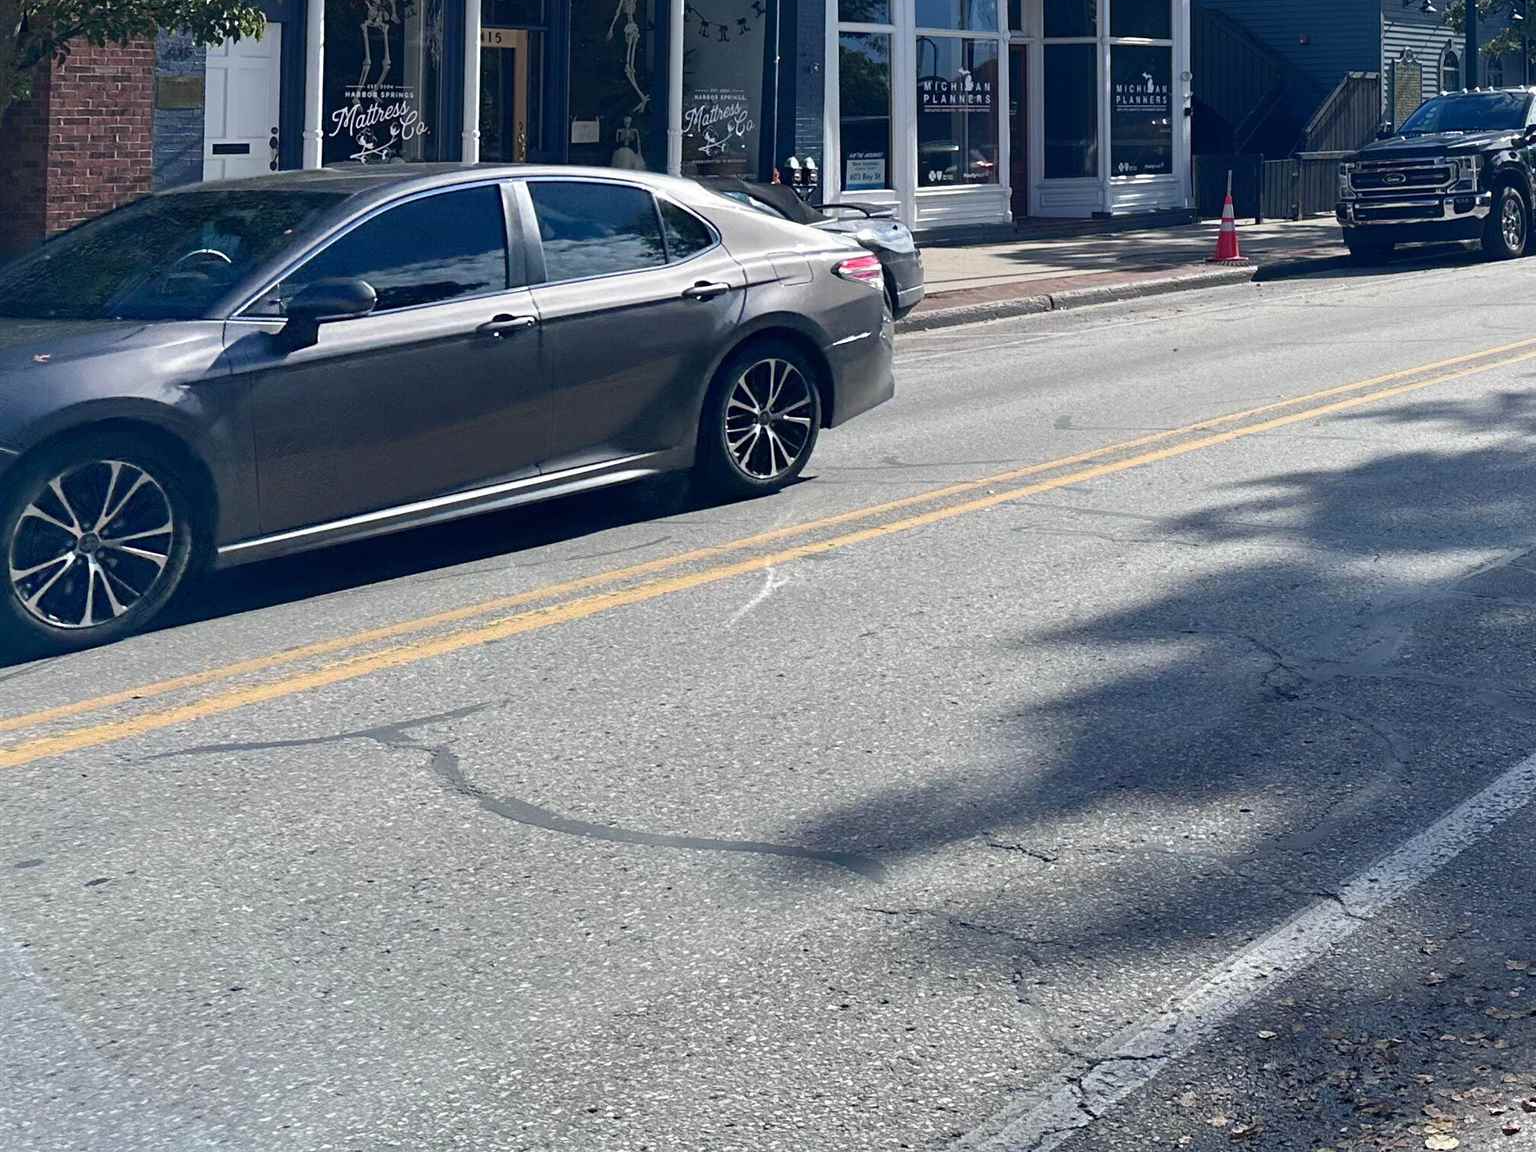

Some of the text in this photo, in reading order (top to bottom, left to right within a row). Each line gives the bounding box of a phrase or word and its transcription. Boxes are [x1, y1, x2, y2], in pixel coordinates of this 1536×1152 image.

[923, 94, 991, 104] PLANNERS
[1115, 95, 1168, 105] PLANNERS
[328, 100, 410, 137] Mattress
[399, 110, 431, 140] Co.
[681, 101, 742, 133] Mattress
